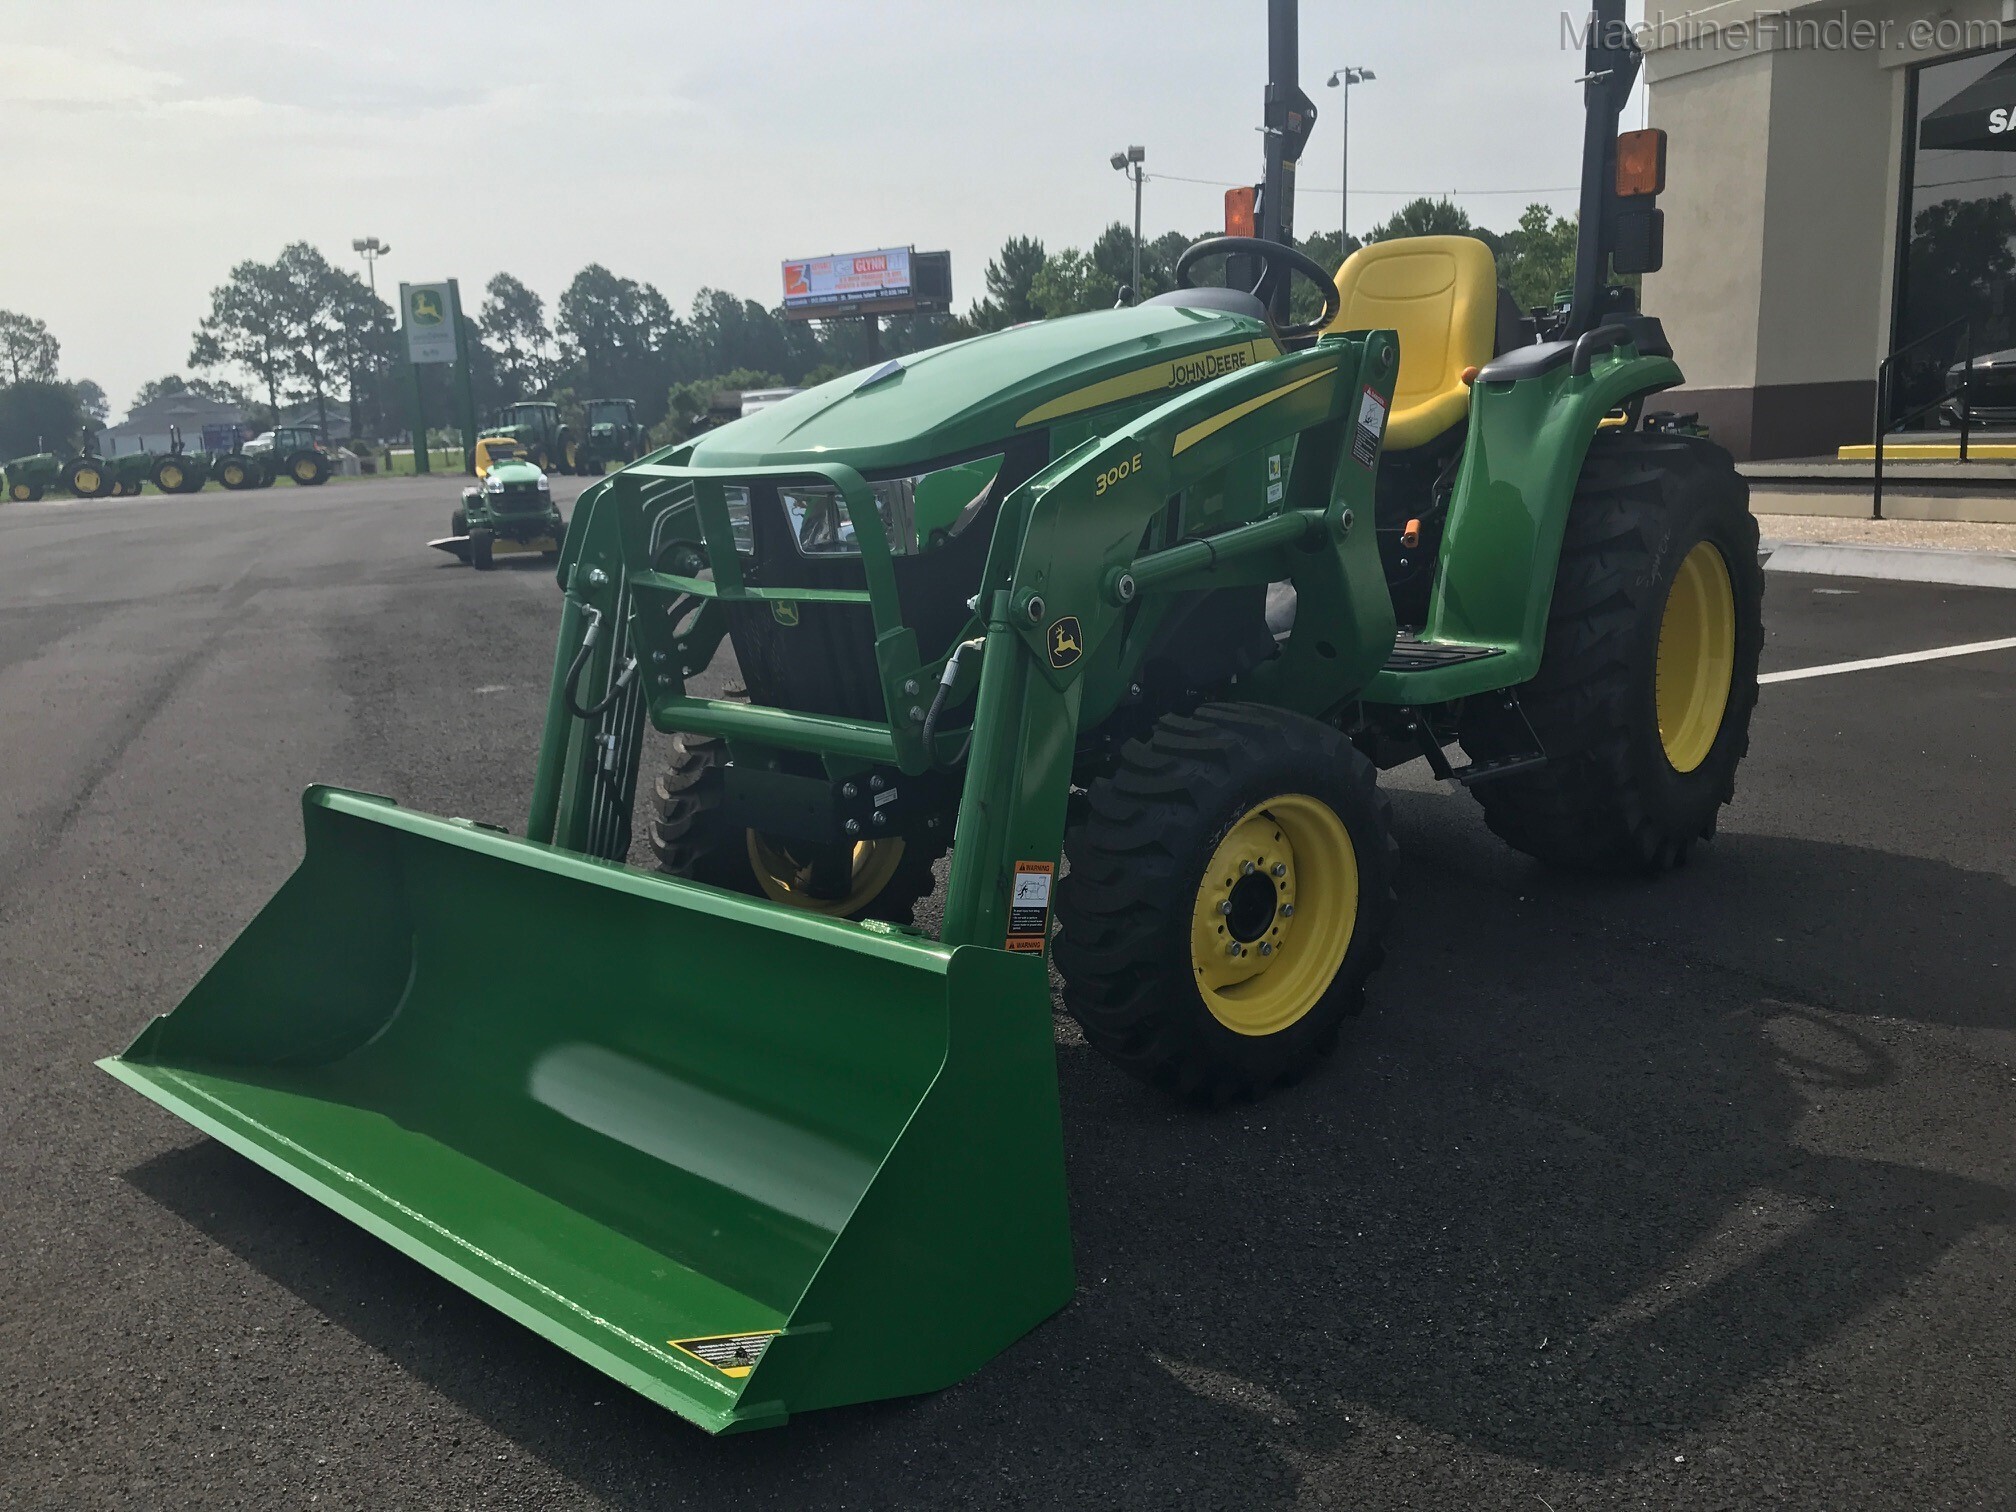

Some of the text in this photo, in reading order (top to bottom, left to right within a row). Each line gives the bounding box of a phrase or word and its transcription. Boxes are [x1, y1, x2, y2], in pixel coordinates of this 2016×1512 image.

[855, 256, 887, 273] GLYNN
[1025, 864, 1050, 872] WARNING
[1016, 941, 1041, 949] WARNING
